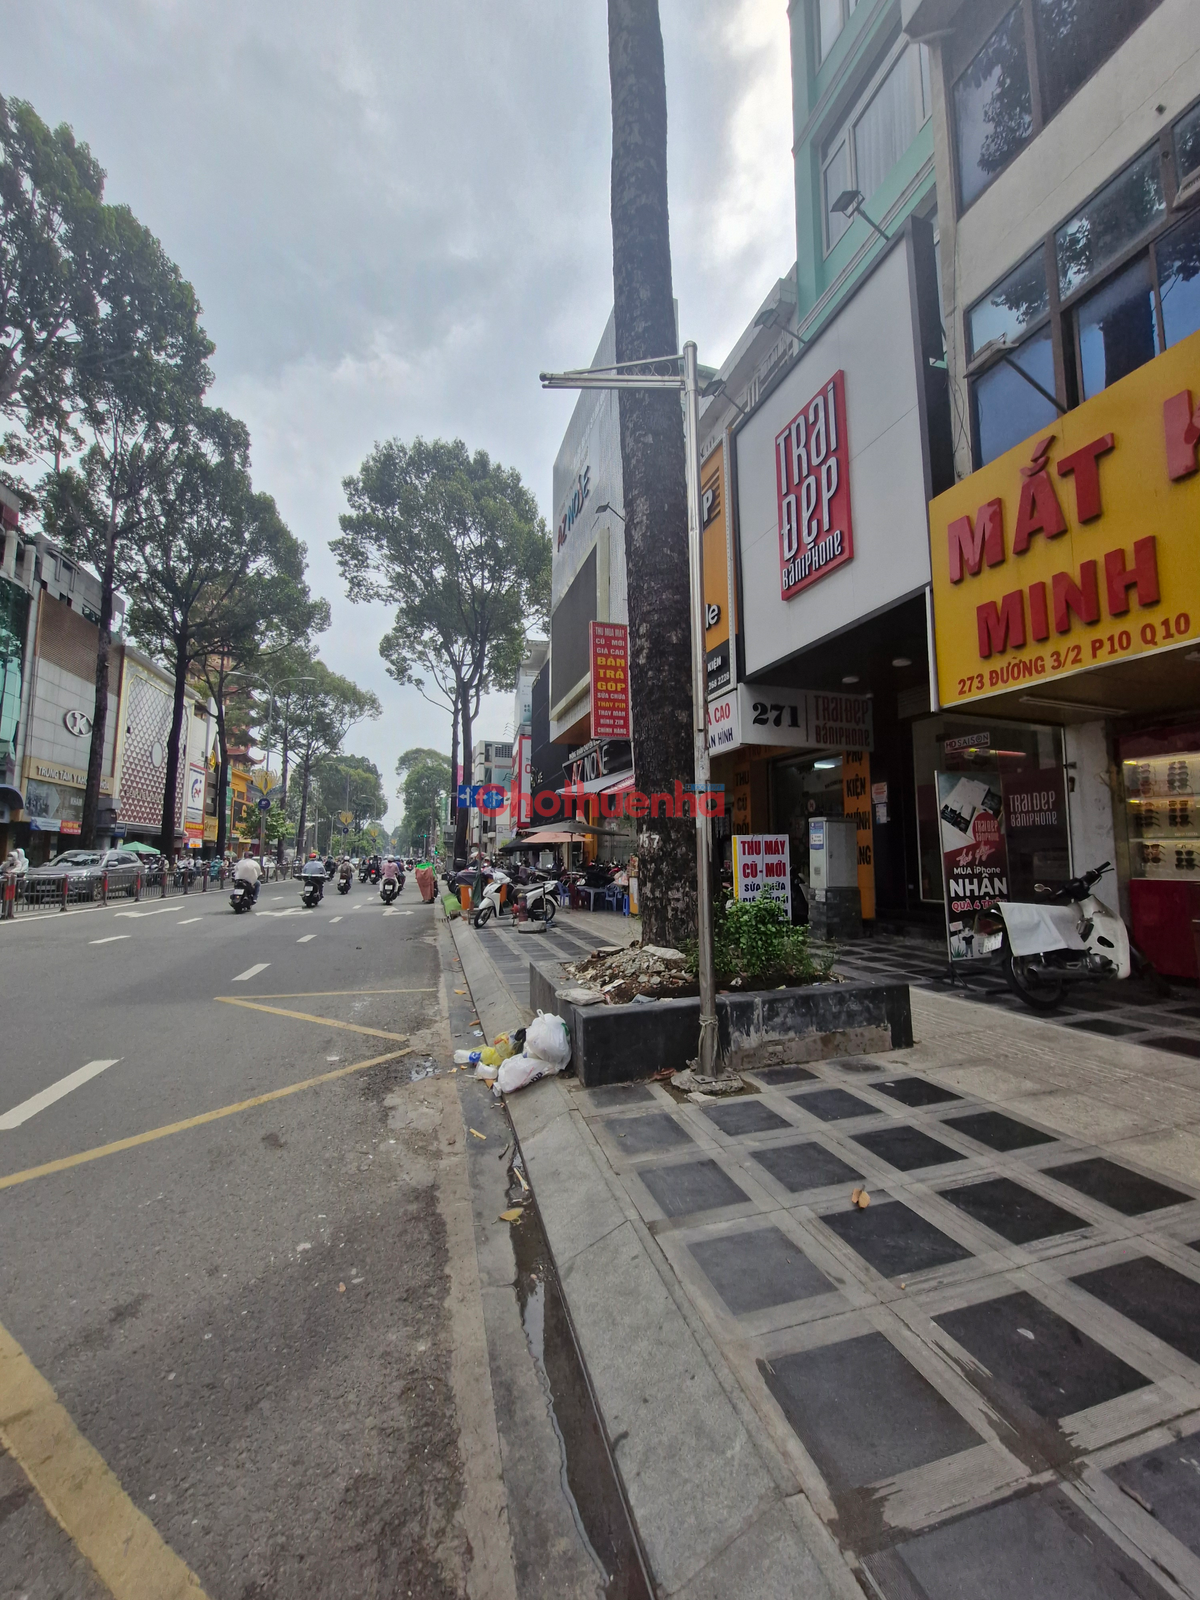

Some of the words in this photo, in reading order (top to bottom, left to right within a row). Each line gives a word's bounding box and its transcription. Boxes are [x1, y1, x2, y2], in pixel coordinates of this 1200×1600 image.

[947, 432, 1115, 585] MẮT
[976, 535, 1161, 660] MINH
[610, 648, 625, 656] CAO
[958, 674, 985, 696] 273
[989, 656, 1046, 687] ĐƯỜNG
[1050, 645, 1082, 671] 3/2
[1091, 630, 1132, 659] P10
[1141, 613, 1190, 646] Q10
[714, 702, 731, 724] CAO
[752, 702, 800, 728] 271
[718, 726, 734, 745] HÌNH
[945, 740, 957, 749] HD
[957, 733, 989, 747] SAISON
[846, 774, 866, 801] KIỆN
[740, 840, 762, 856] THU
[764, 838, 786, 855] MÁY
[742, 860, 758, 879] CŨ
[765, 859, 787, 878] MỚI
[953, 867, 972, 875] MUA
[973, 865, 1001, 875] iPhone
[951, 898, 973, 913] QUÀ
[973, 900, 981, 911] 4
